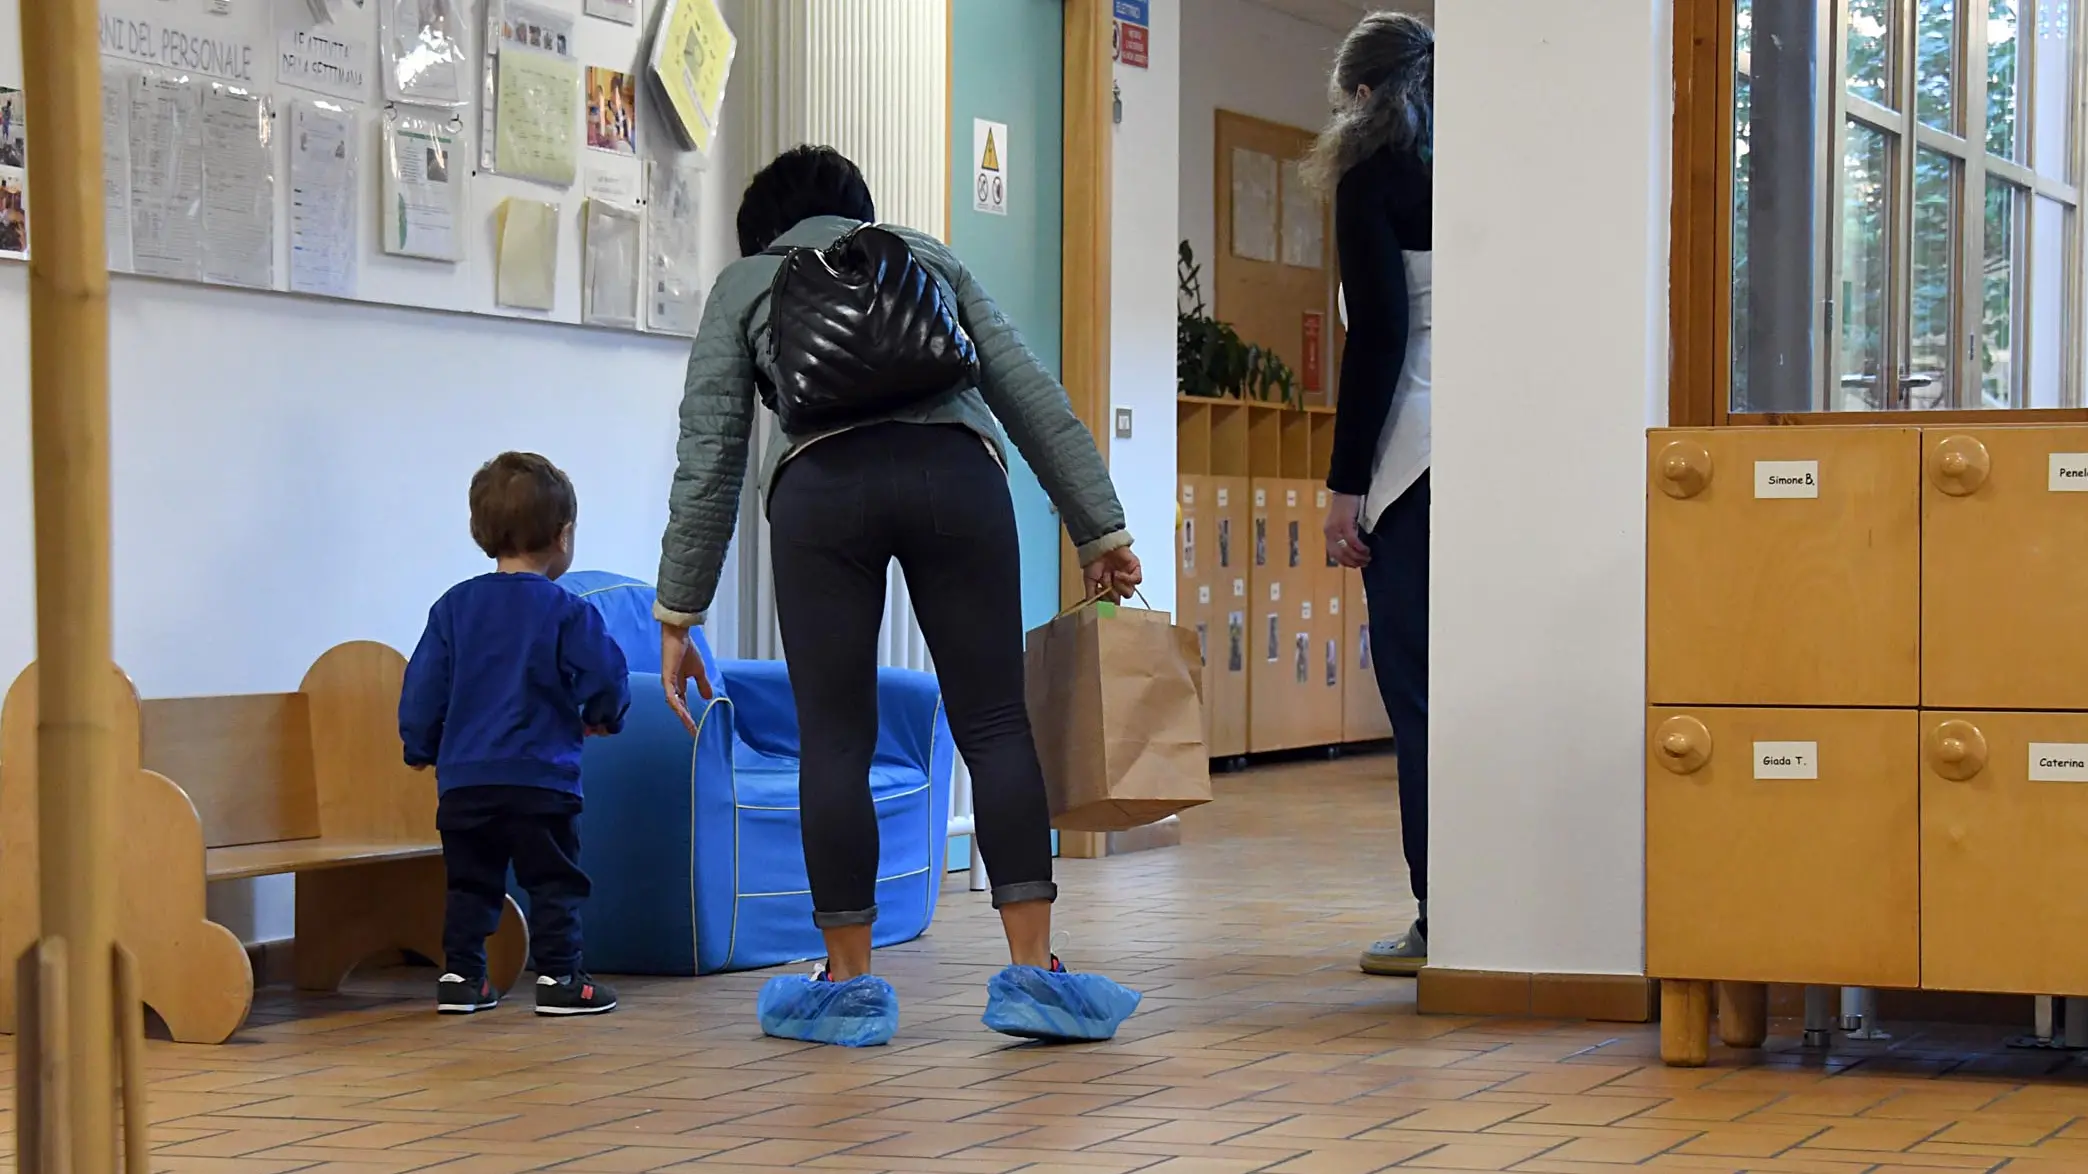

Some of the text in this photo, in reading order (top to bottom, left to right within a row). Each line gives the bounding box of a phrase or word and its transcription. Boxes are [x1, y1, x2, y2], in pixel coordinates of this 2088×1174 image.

[128, 20, 156, 58] DEL
[161, 28, 252, 80] PERSONALE
[2059, 467, 2088, 478] Penel
[1768, 472, 1815, 486] Simone B.
[1763, 756, 1807, 766] Giada T.
[2039, 757, 2085, 768] Caterina
